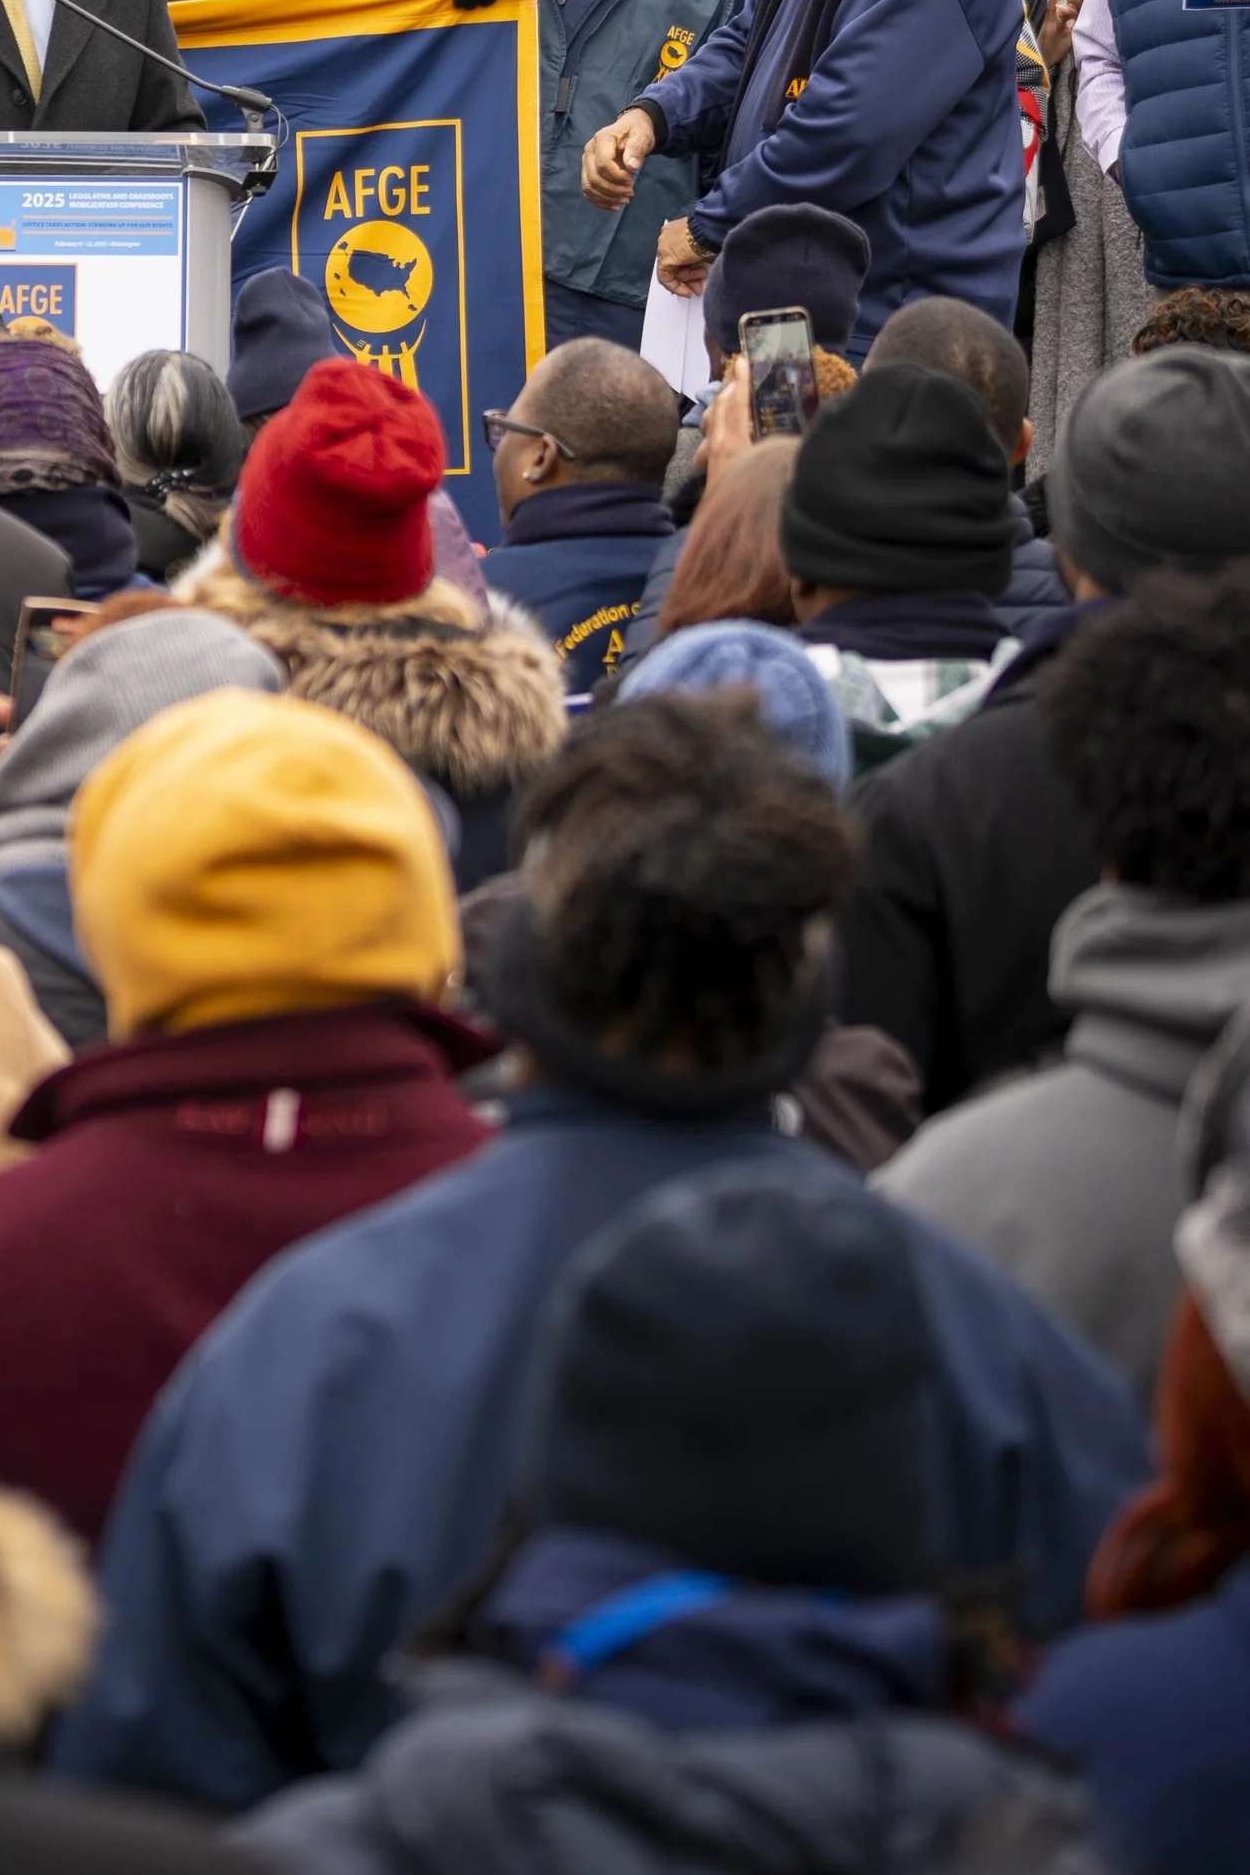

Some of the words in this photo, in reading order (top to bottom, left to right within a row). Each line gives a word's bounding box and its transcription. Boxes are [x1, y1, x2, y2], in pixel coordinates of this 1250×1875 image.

[666, 25, 695, 46] AFGE
[21, 192, 66, 209] 2025
[323, 165, 431, 220] AFGE
[119, 201, 164, 209] CONFERENCE
[554, 604, 630, 660] Federation
